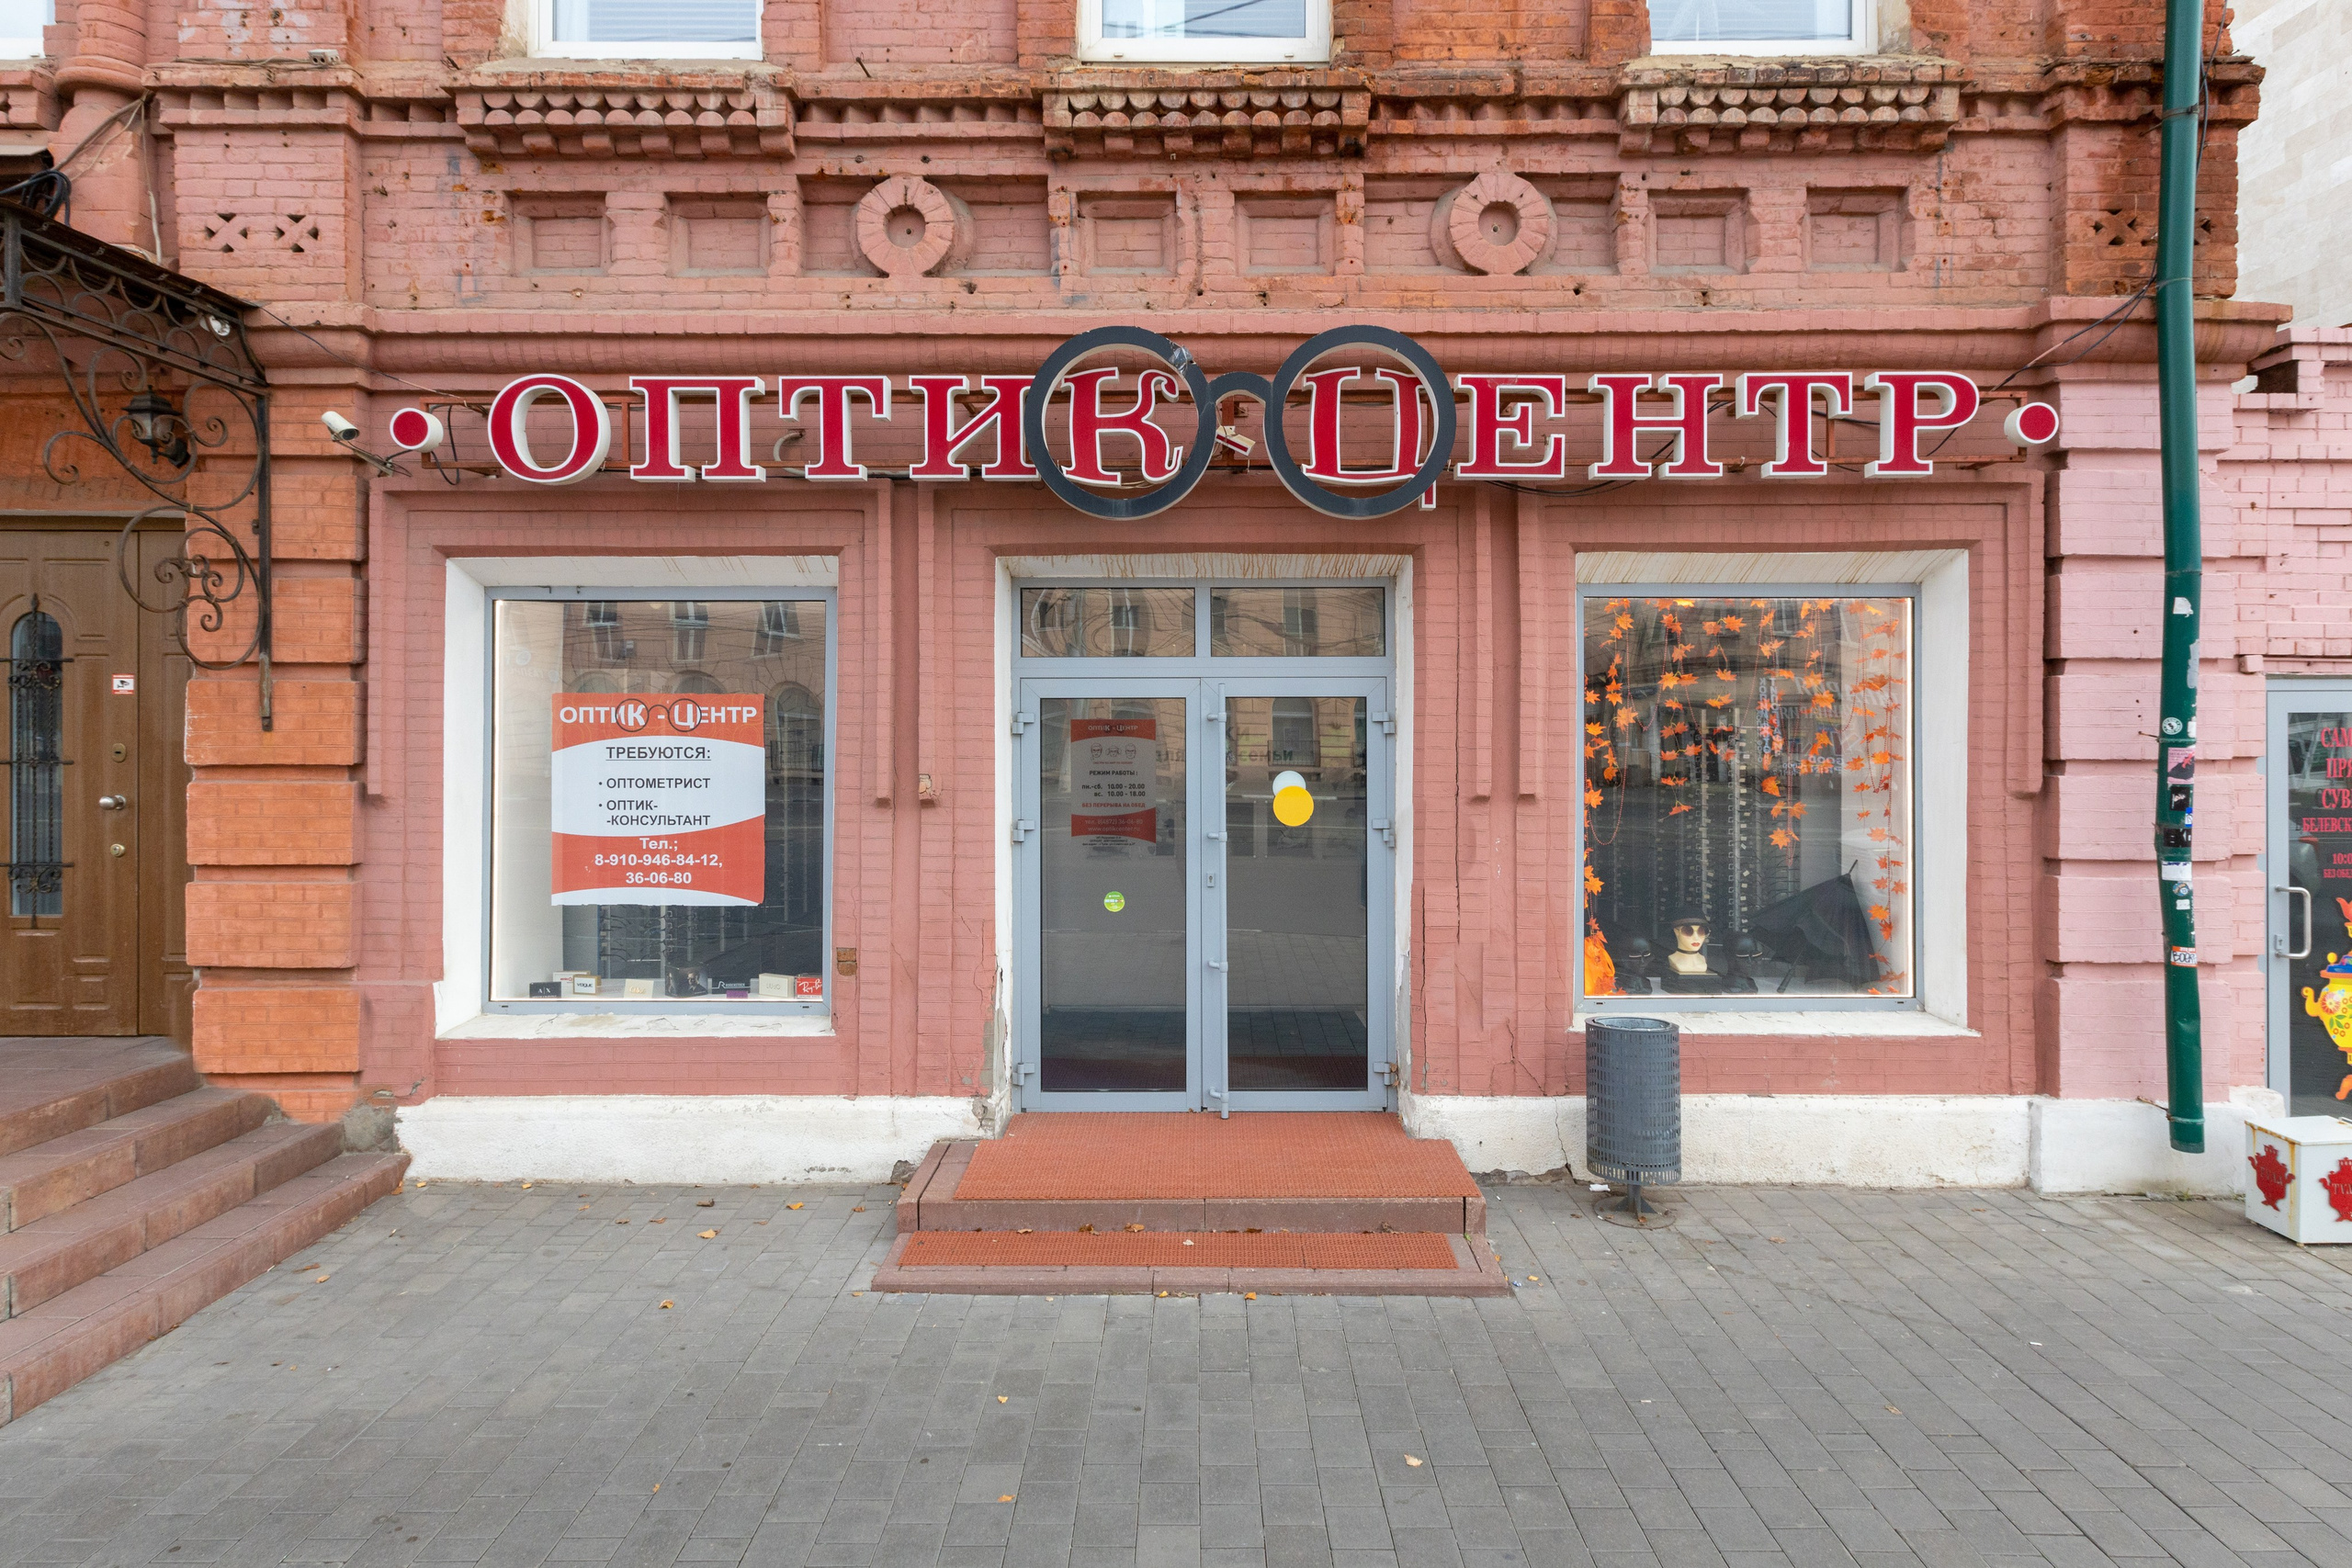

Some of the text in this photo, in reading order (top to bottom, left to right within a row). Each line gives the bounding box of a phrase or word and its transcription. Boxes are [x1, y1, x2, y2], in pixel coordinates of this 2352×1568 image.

[487, 367, 1981, 511] ОПТИК ЦЕНТР
[560, 704, 647, 727] ОПТИК
[673, 704, 757, 728] ЦЕНТР
[2321, 728, 2352, 748] САМ
[605, 747, 711, 760] ТРЕБУЮТСЯ:
[606, 778, 711, 789] ОПТОМЕТРИСТ
[2322, 788, 2352, 808] СУВ
[606, 800, 658, 811] ОПТИК-
[606, 815, 711, 826] -КОНСУЛЬТАНТ
[594, 853, 723, 867] 8-910-946-84-12,
[626, 872, 692, 885] 36-06-80
